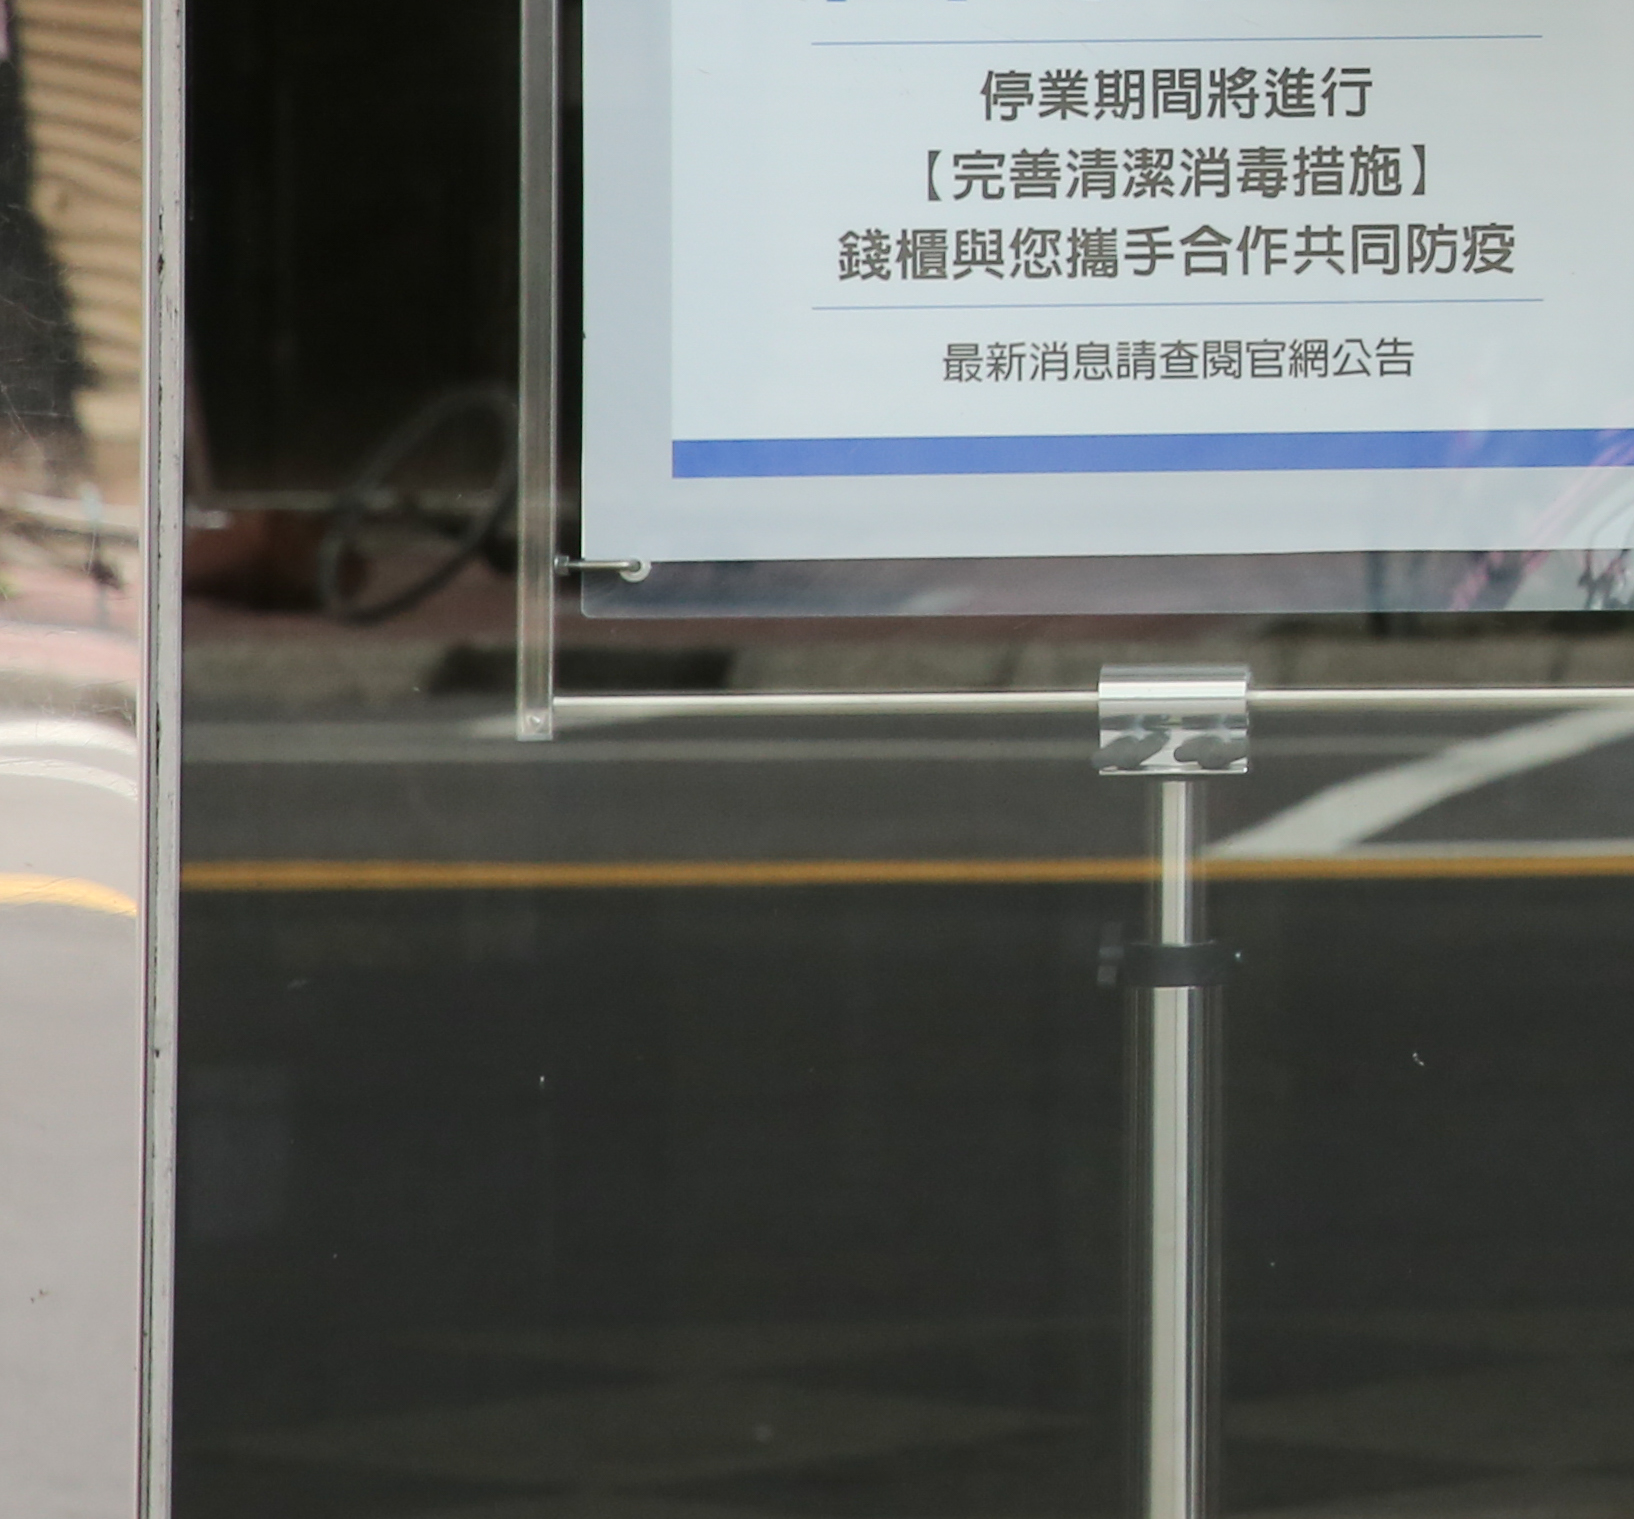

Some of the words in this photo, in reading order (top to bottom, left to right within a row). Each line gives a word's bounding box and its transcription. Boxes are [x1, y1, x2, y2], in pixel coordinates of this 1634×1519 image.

[980, 67, 1373, 122] 停業期間將進行
[925, 144, 1430, 201] 【完善清潔消毒措施】
[838, 223, 1516, 281] 錢櫃與您攜手合作共同防疫
[942, 338, 1415, 385] 最新消息請查閱官網公告
